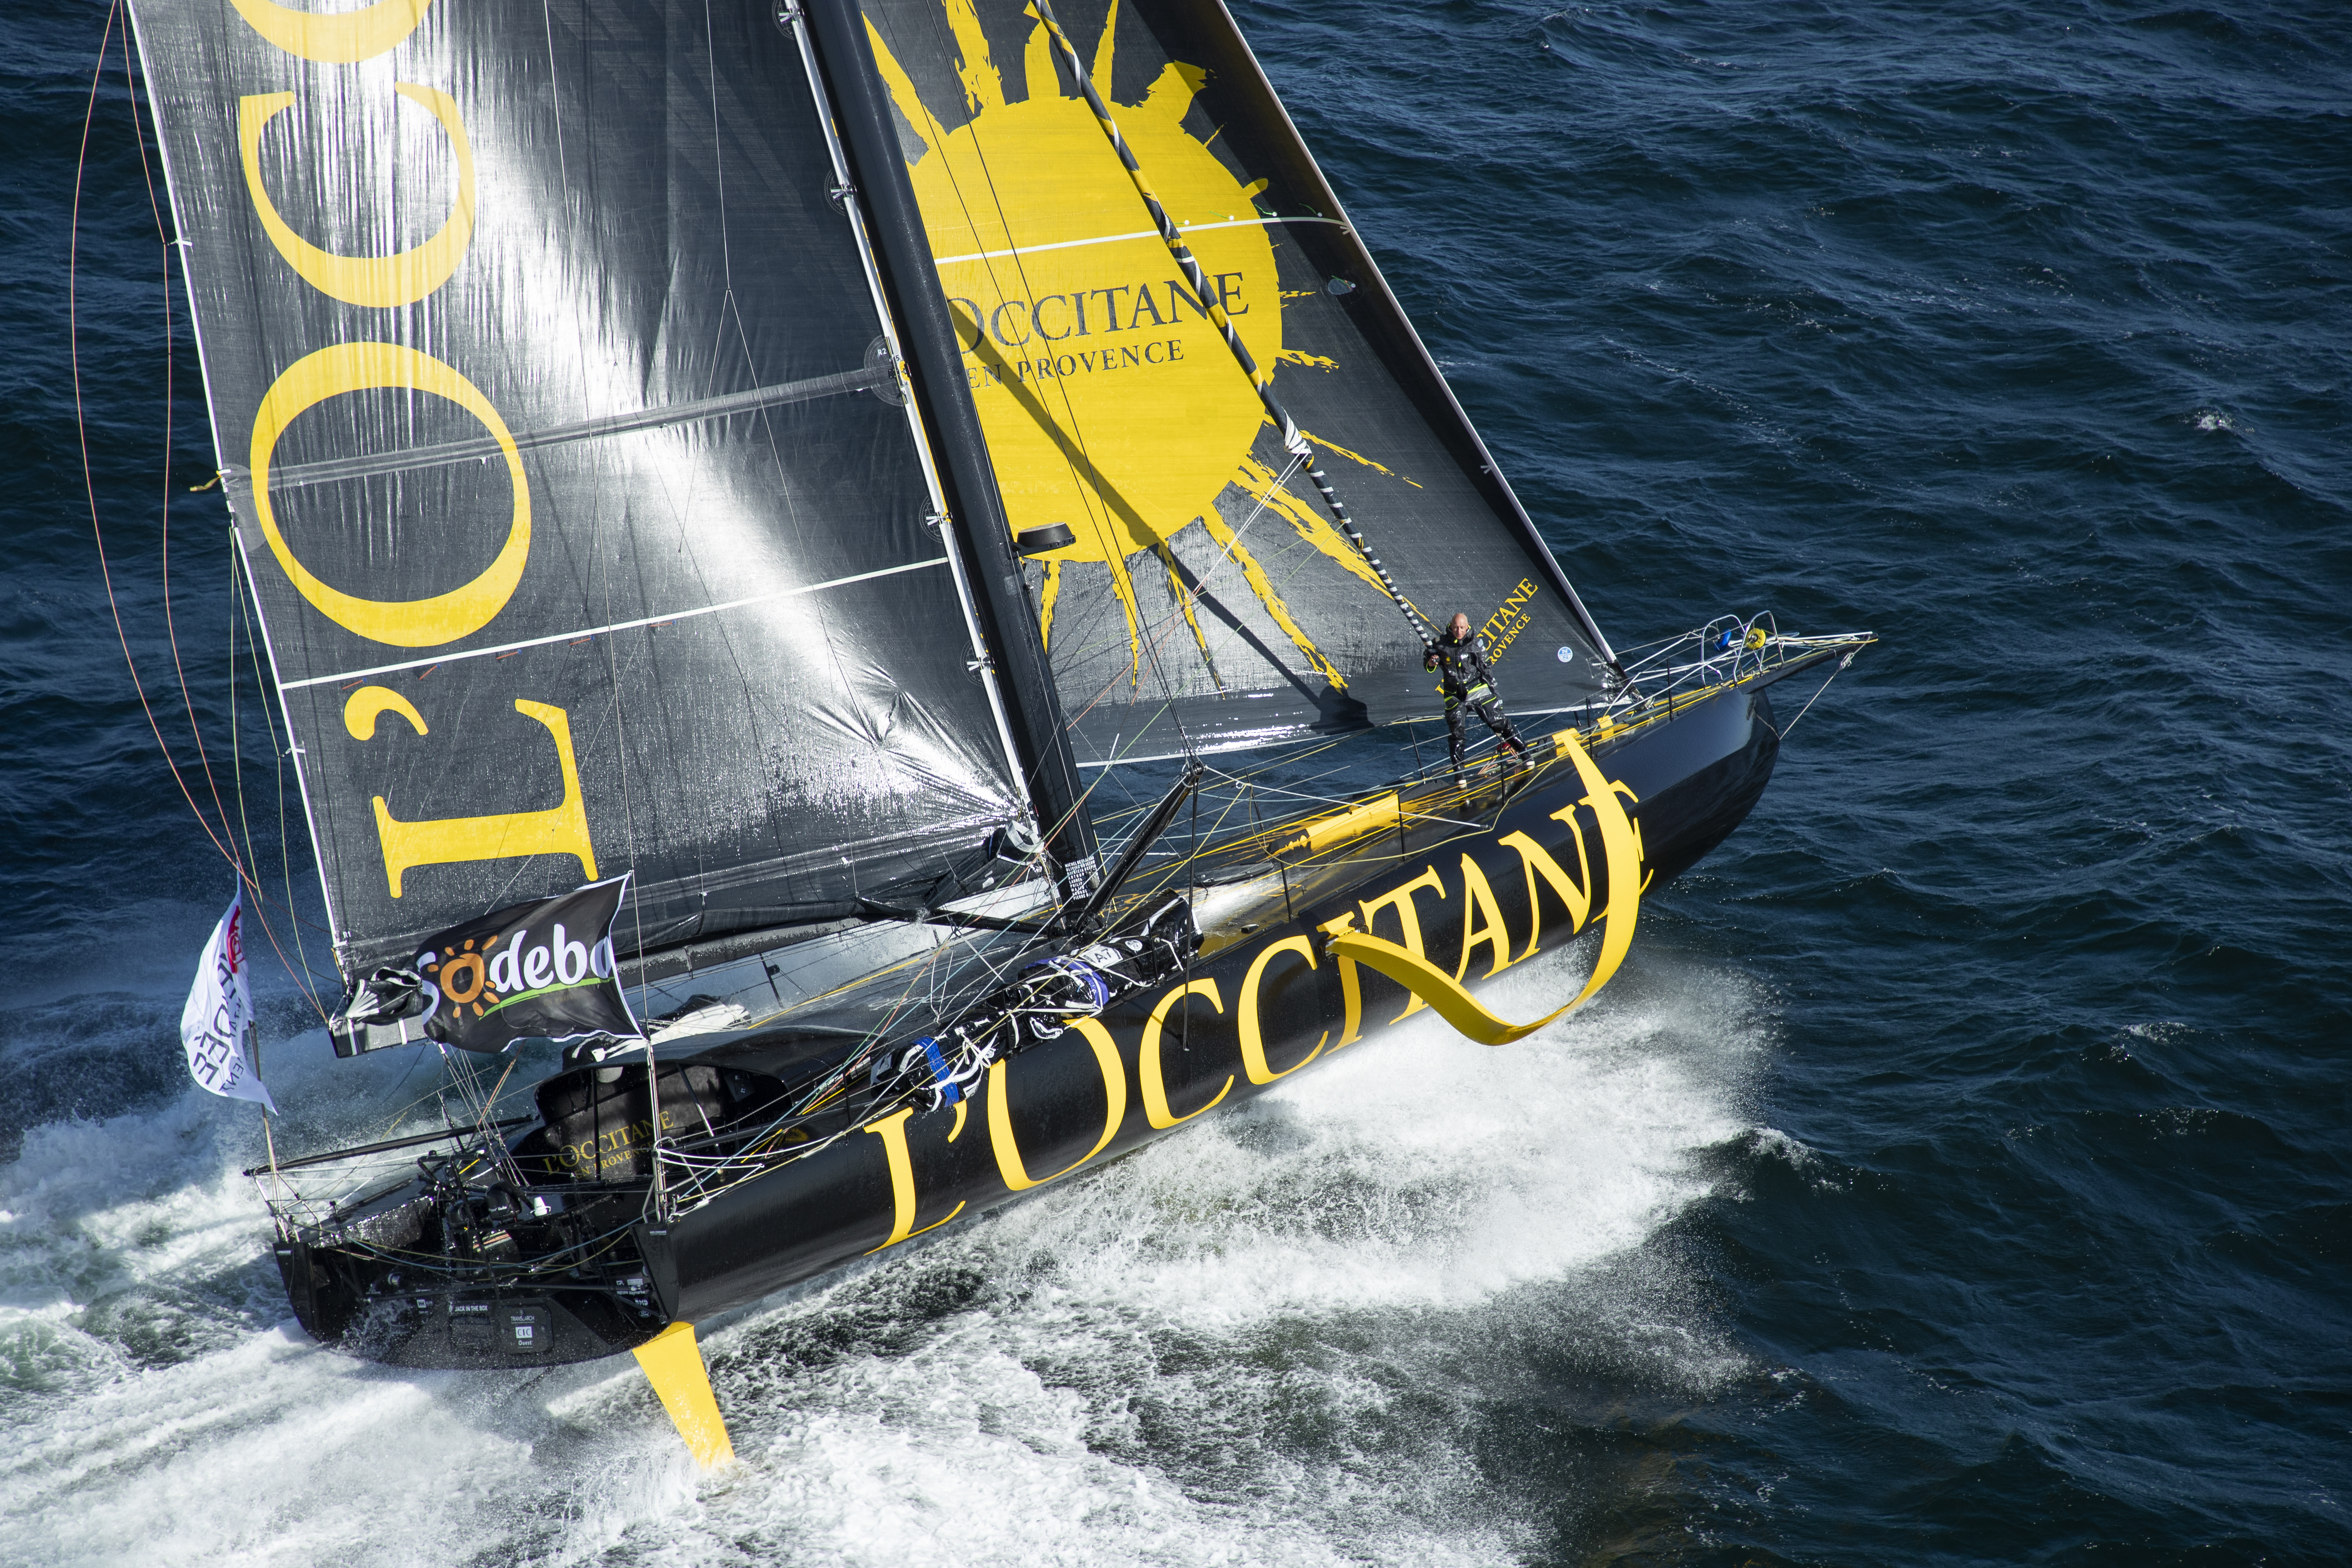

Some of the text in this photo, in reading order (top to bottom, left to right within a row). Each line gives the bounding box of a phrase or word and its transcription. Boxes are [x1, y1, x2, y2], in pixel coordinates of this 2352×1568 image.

[877, 348, 887, 356] R2
[968, 339, 1184, 389] EN PROVENCE
[229, 0, 599, 898] L'OC
[1094, 948, 1112, 963] A7
[518, 1328, 531, 1336] CIC
